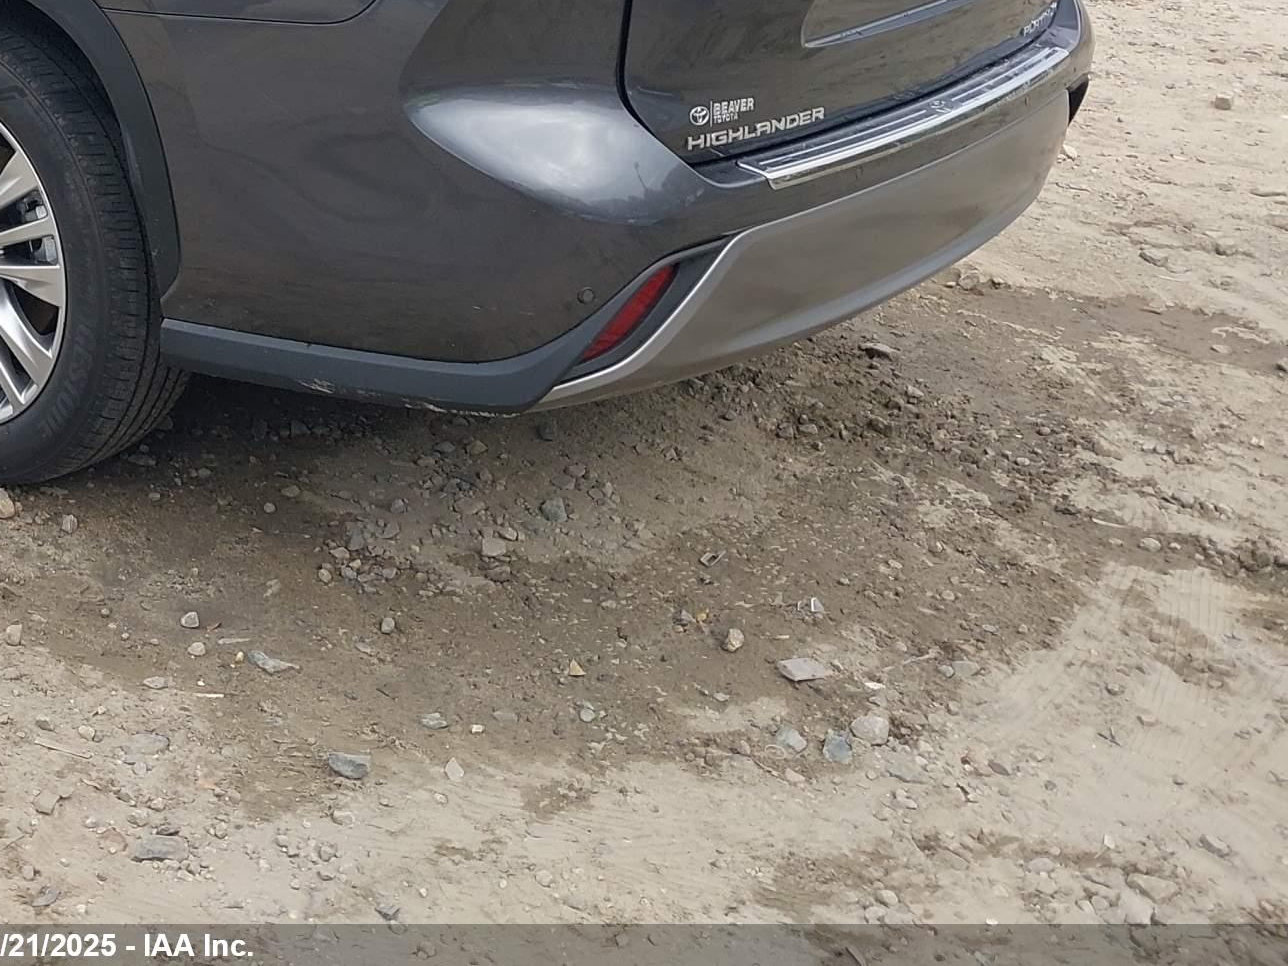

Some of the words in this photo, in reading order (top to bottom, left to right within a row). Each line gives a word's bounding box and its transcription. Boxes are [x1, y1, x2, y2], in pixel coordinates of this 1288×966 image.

[713, 97, 754, 115] BEAVER
[713, 112, 739, 124] TOYOTA
[687, 106, 825, 151] HIGHLANDER
